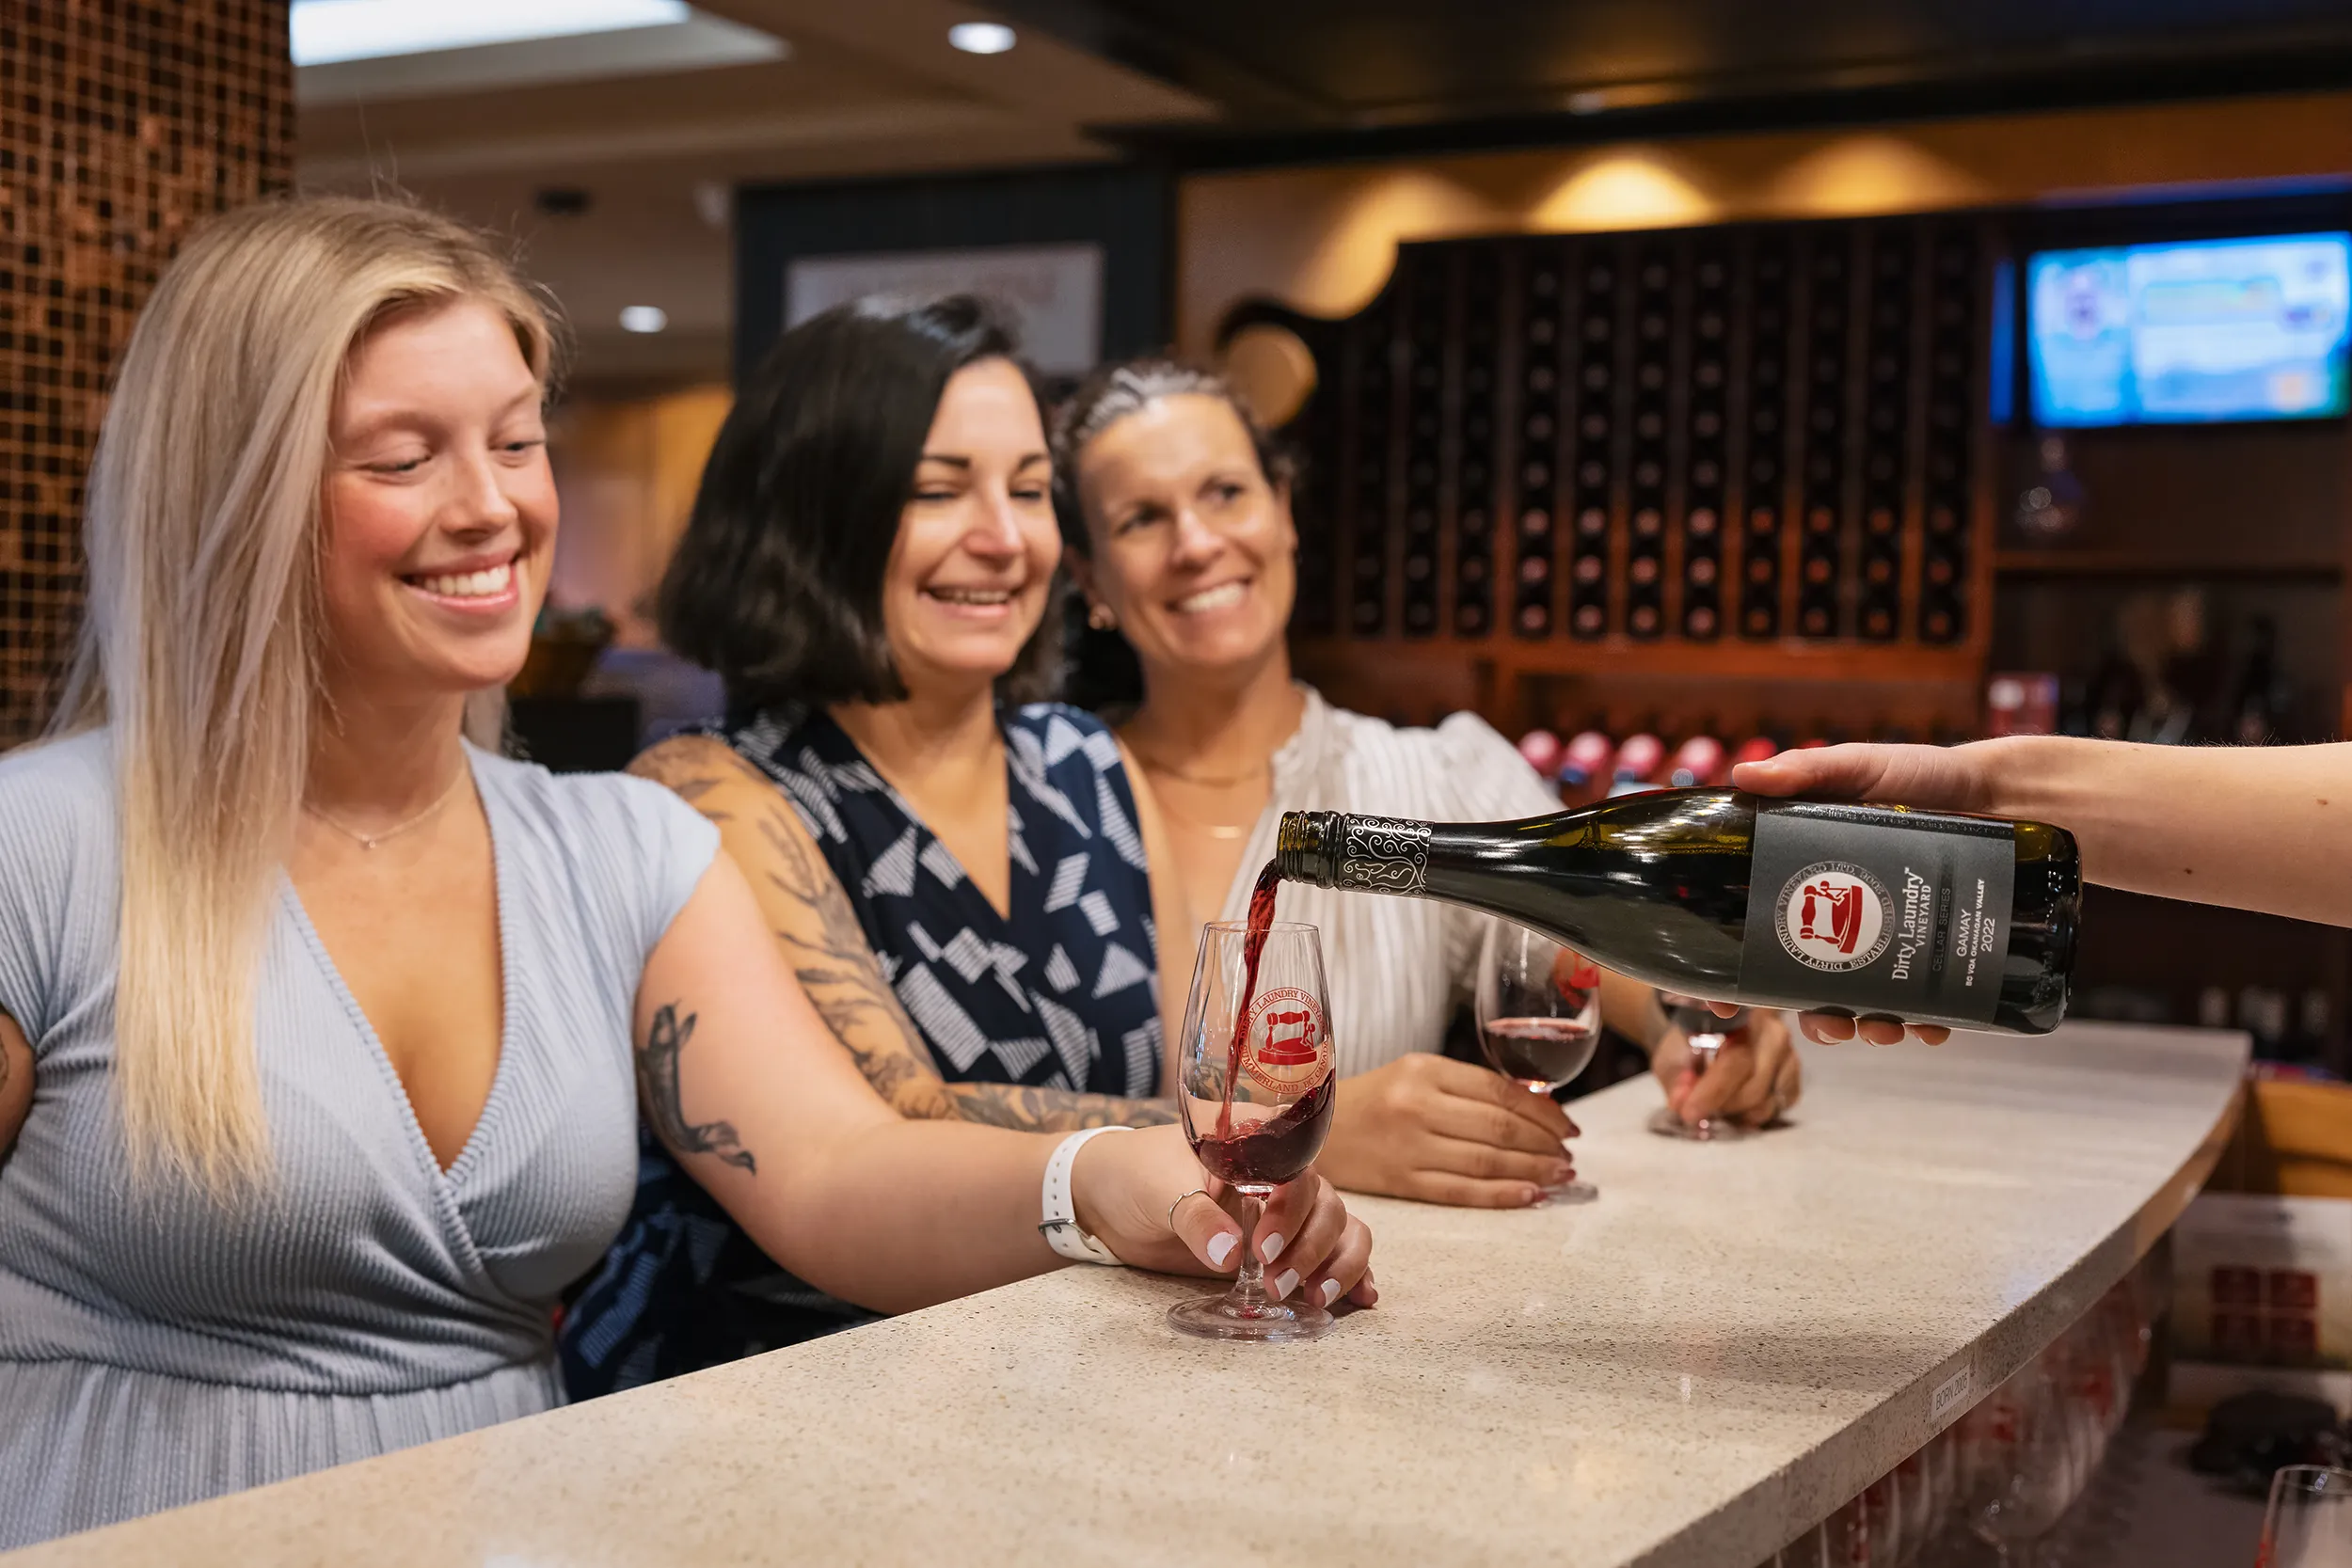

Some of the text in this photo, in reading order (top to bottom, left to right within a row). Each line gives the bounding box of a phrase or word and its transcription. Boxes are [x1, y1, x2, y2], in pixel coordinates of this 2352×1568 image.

[1779, 864, 1826, 908] VINEYARD
[1777, 912, 1804, 961] LAUNDRY
[1850, 896, 1893, 968] ESTABLISHED
[1915, 885, 1931, 947] VINEYARD
[1932, 888, 1950, 971] CELLAR SERIES
[1957, 909, 1971, 957] GAMAY
[1971, 911, 1981, 957] OKANAGAN
[1977, 879, 1985, 910] VALLEY
[1981, 918, 1995, 952] 2022
[1805, 958, 1843, 970] DIRTY
[1892, 942, 1915, 979] Dirty
[1256, 990, 1299, 1009] LAUNDRY
[1241, 1044, 1298, 1091] SUMMERLAND
[1315, 1040, 1328, 1078] CANADA
[1935, 1383, 1954, 1410] BORN
